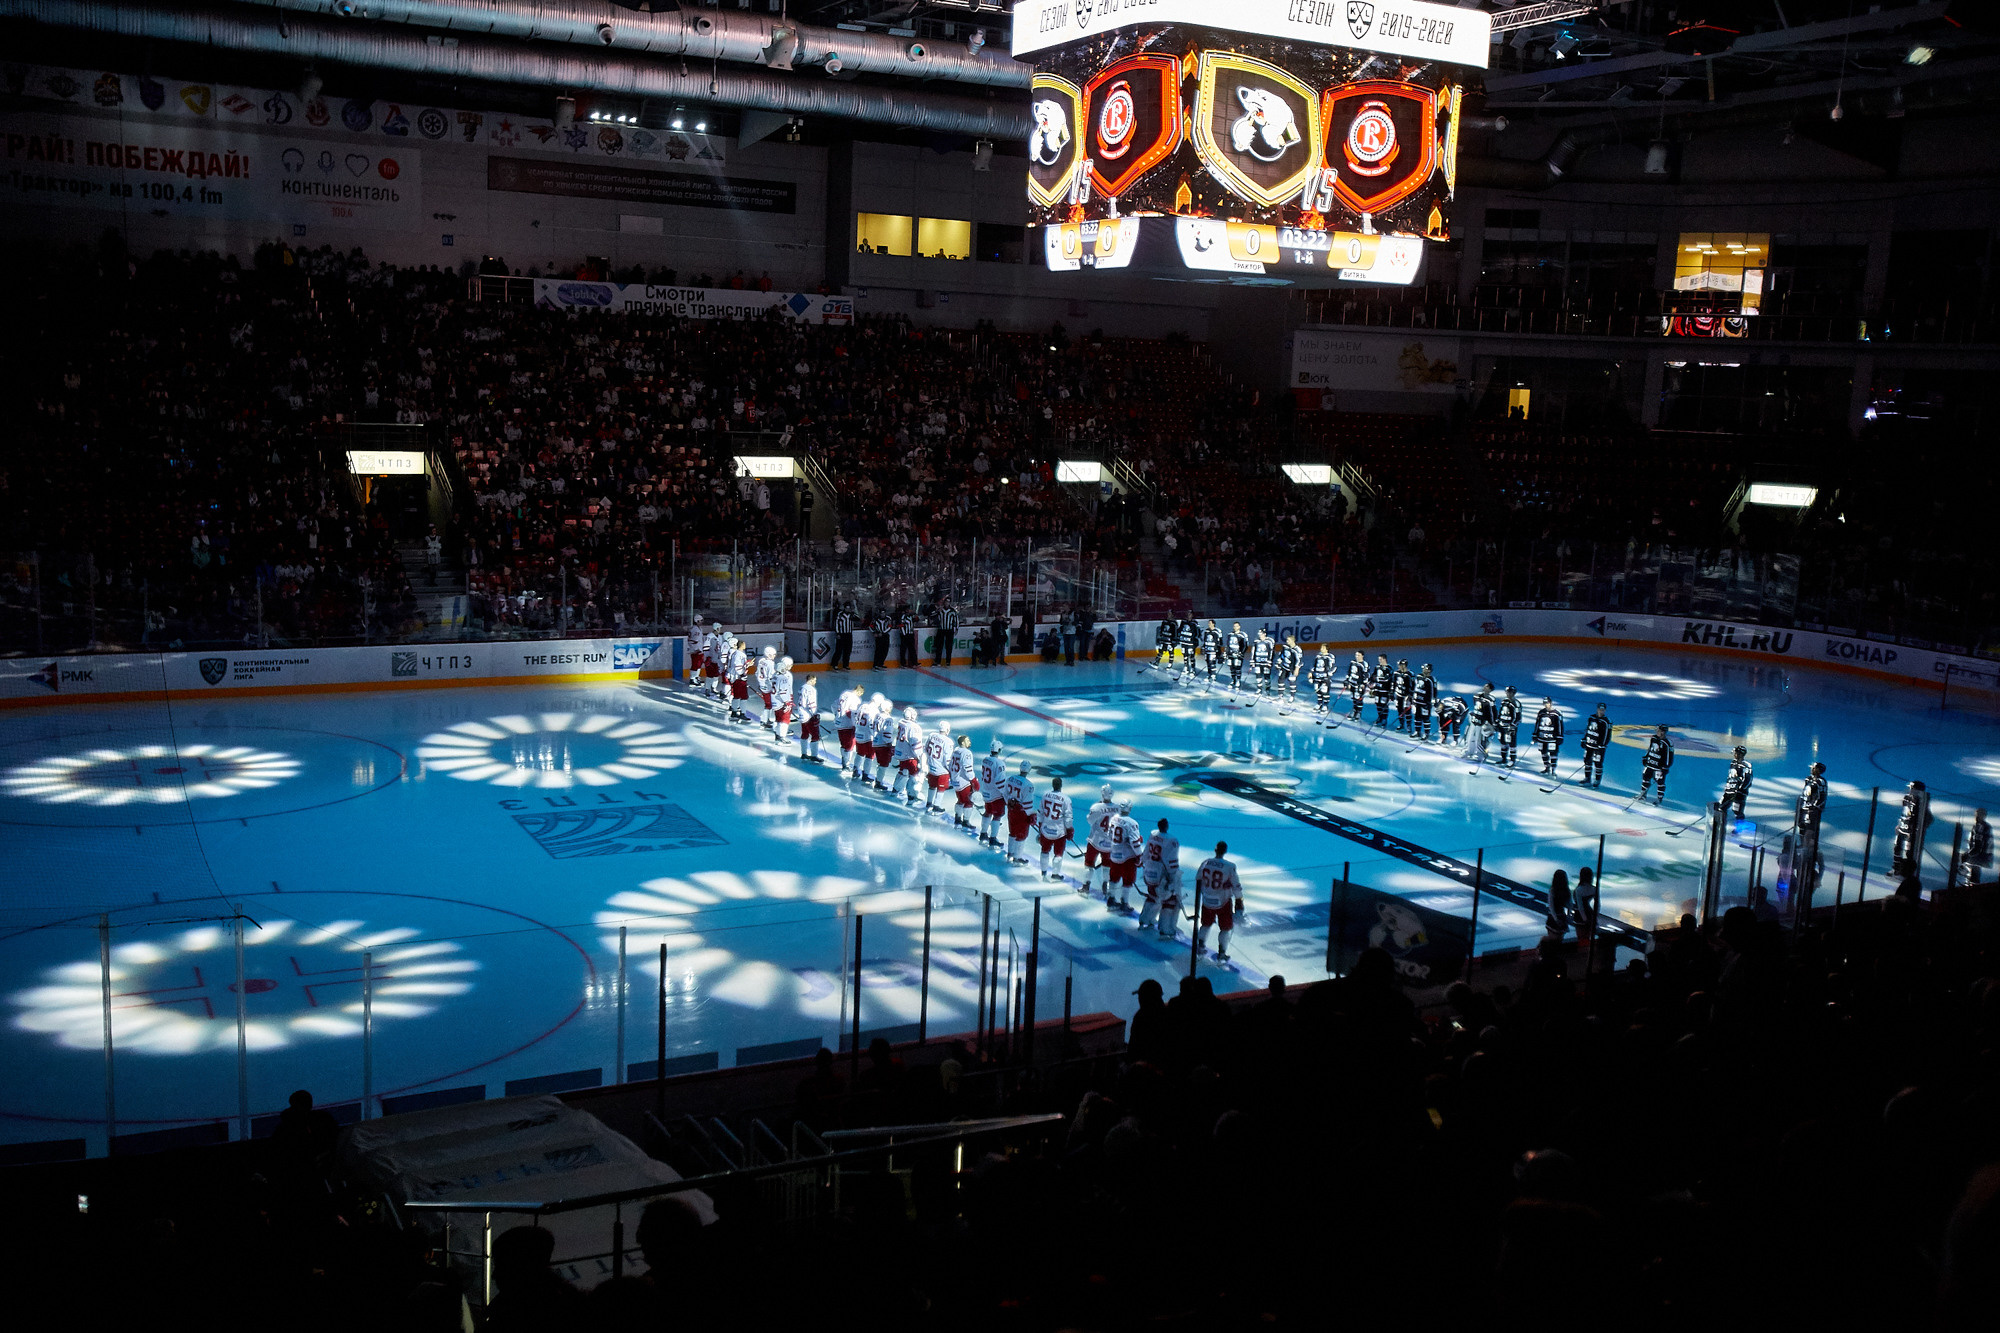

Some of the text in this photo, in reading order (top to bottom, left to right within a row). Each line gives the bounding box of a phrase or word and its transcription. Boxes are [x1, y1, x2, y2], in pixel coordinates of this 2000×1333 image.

[1288, 0, 1454, 45] СЕЗОН 2019-2020
[0, 133, 250, 180] РАЙ! ПОБЕЖДАЙ!
[110, 182, 133, 198] на
[140, 182, 192, 204] 100,4
[200, 186, 223, 204] fm
[1245, 229, 1362, 264] 0 03:22 0
[1233, 262, 1262, 271] ТРАКТОР
[645, 284, 705, 303] Смотри
[624, 299, 687, 316] прямые
[1300, 340, 1320, 350] МЫ
[1324, 341, 1362, 352] ЗНАЕМ
[1300, 354, 1377, 365] ЦЕНУ ЗОЛОТА
[1263, 620, 1321, 643] Haier
[1681, 621, 1793, 654] KHL.RU
[233, 658, 310, 667] КОНТИНЕНТАЛЬНАЯ
[422, 655, 472, 670] ЧТПЗ
[523, 652, 608, 665] THE BEST RUN
[614, 648, 651, 667] SAP
[233, 666, 282, 674] ХОККЕЙНАЯ
[1044, 800, 1063, 820] 55
